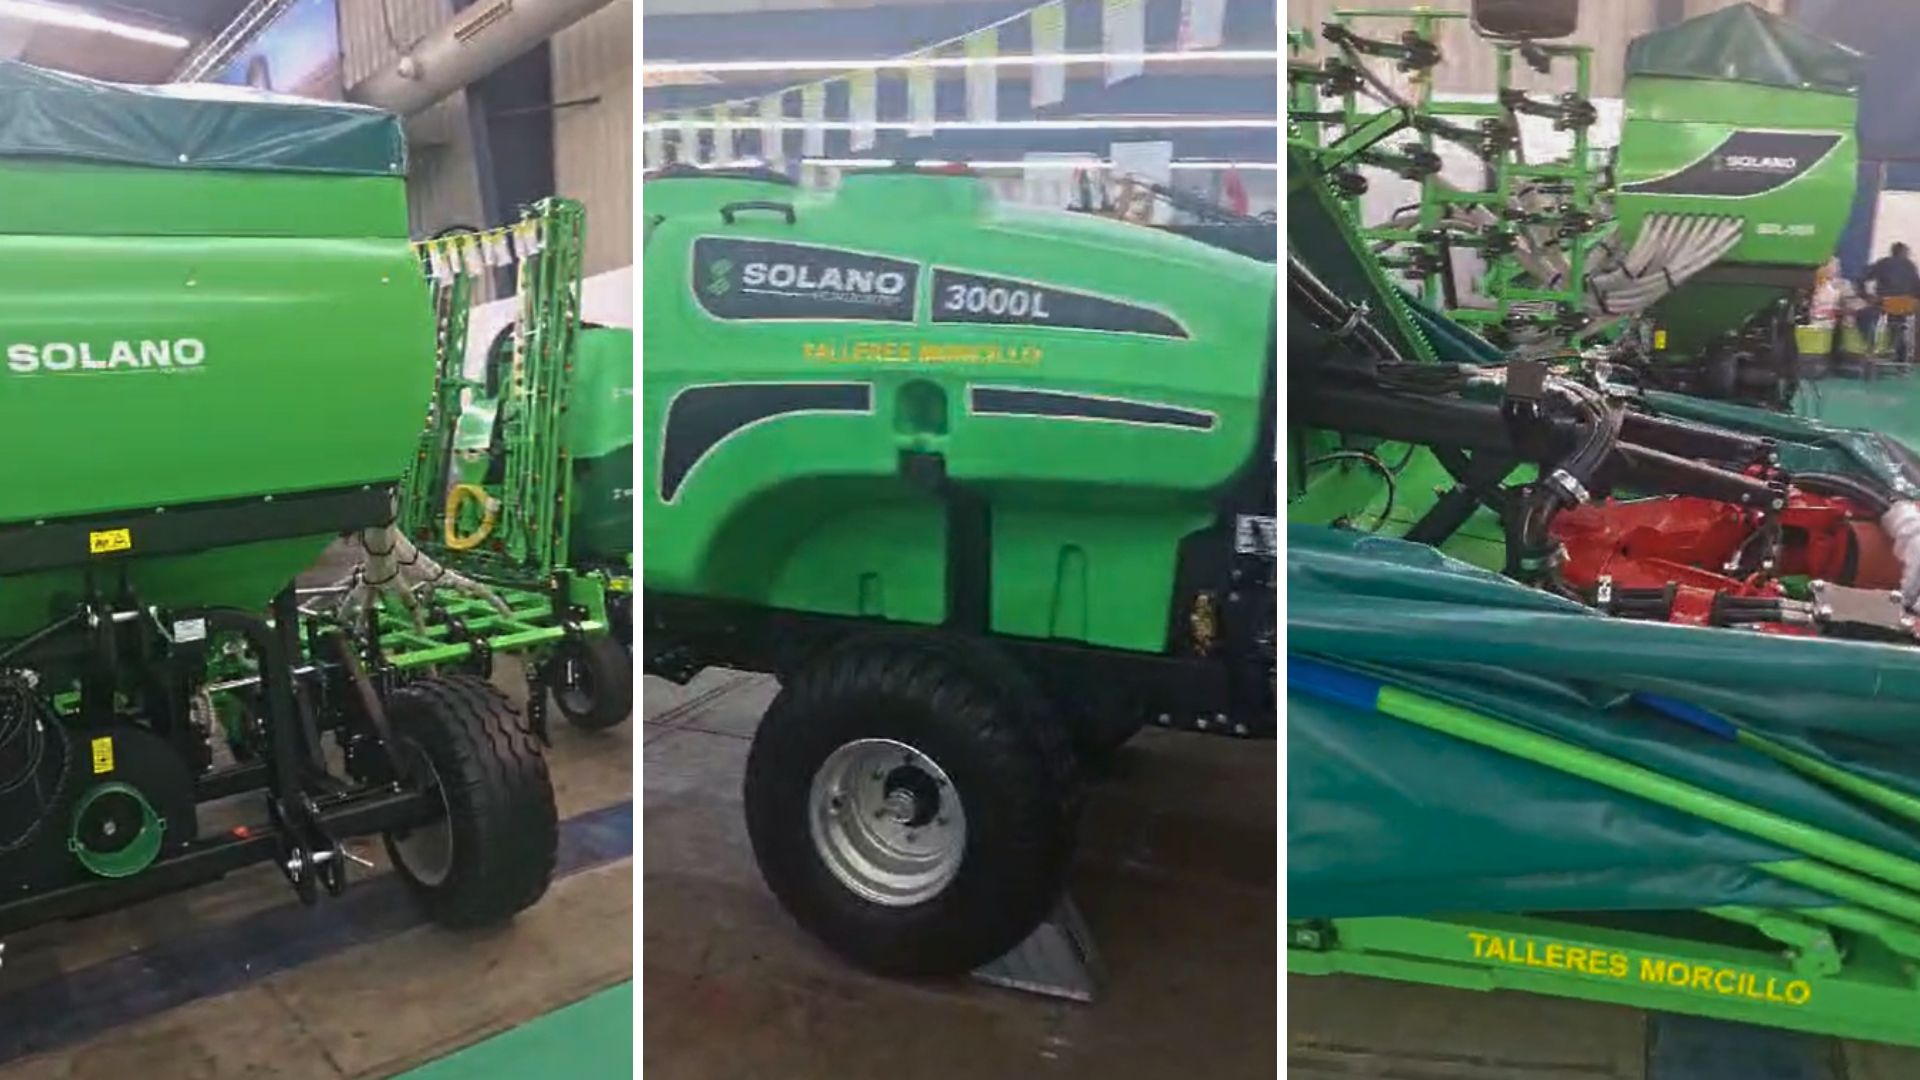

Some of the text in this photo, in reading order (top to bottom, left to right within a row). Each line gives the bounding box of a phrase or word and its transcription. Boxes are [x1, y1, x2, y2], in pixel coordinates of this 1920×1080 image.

[742, 262, 906, 294] SOLANO
[944, 284, 1049, 318] 3000L
[7, 338, 206, 372] SOLANO
[1468, 932, 1811, 1004] TALLERES MORCILLO
